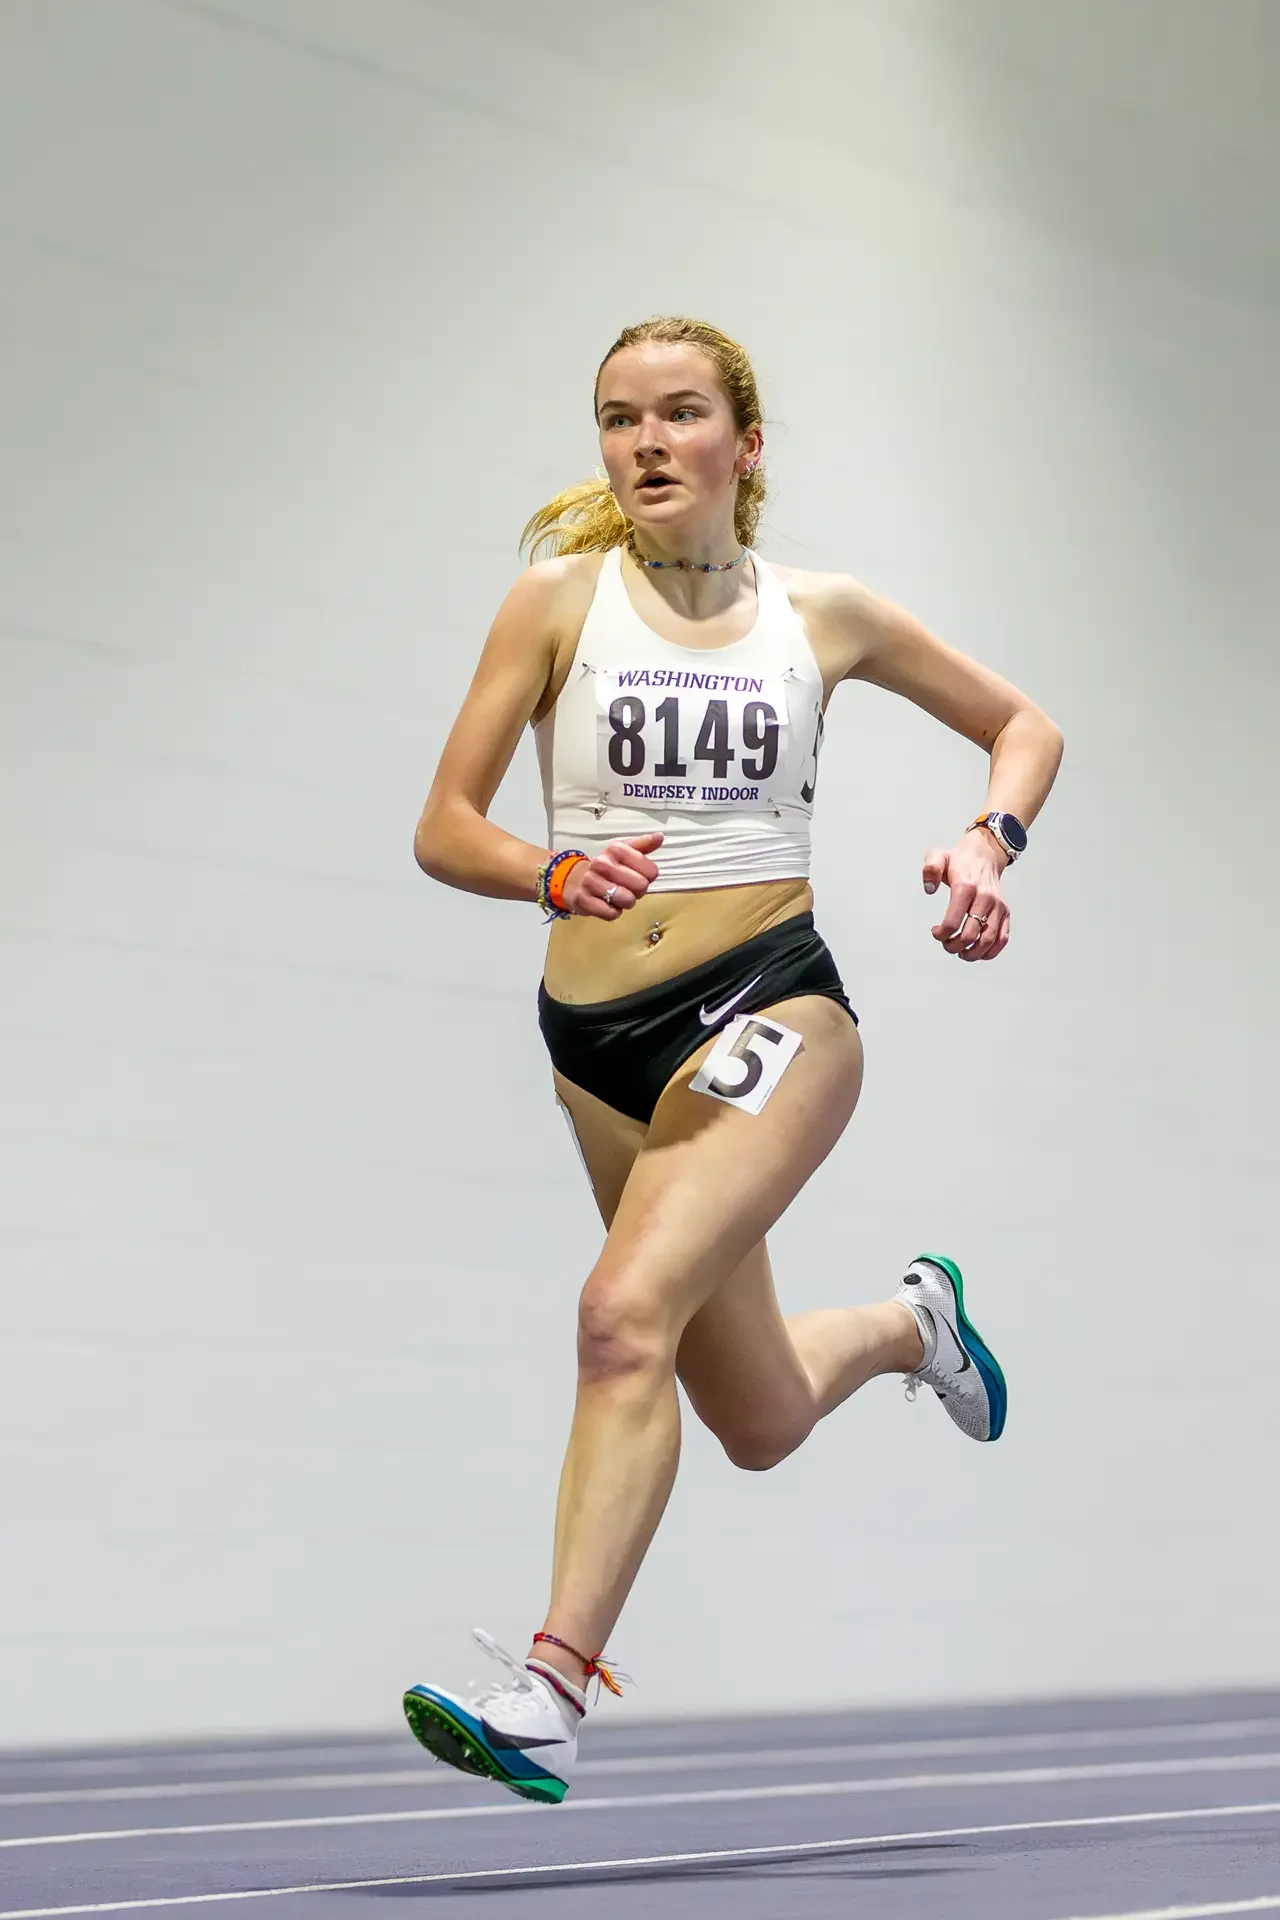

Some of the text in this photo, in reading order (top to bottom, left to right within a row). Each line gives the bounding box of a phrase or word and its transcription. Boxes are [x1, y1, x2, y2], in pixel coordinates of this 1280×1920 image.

[618, 670, 764, 693] WASHINGTON
[608, 696, 780, 781] 8149
[623, 783, 759, 801] DEMPSEY INDOOR
[707, 1020, 784, 1098] 5
